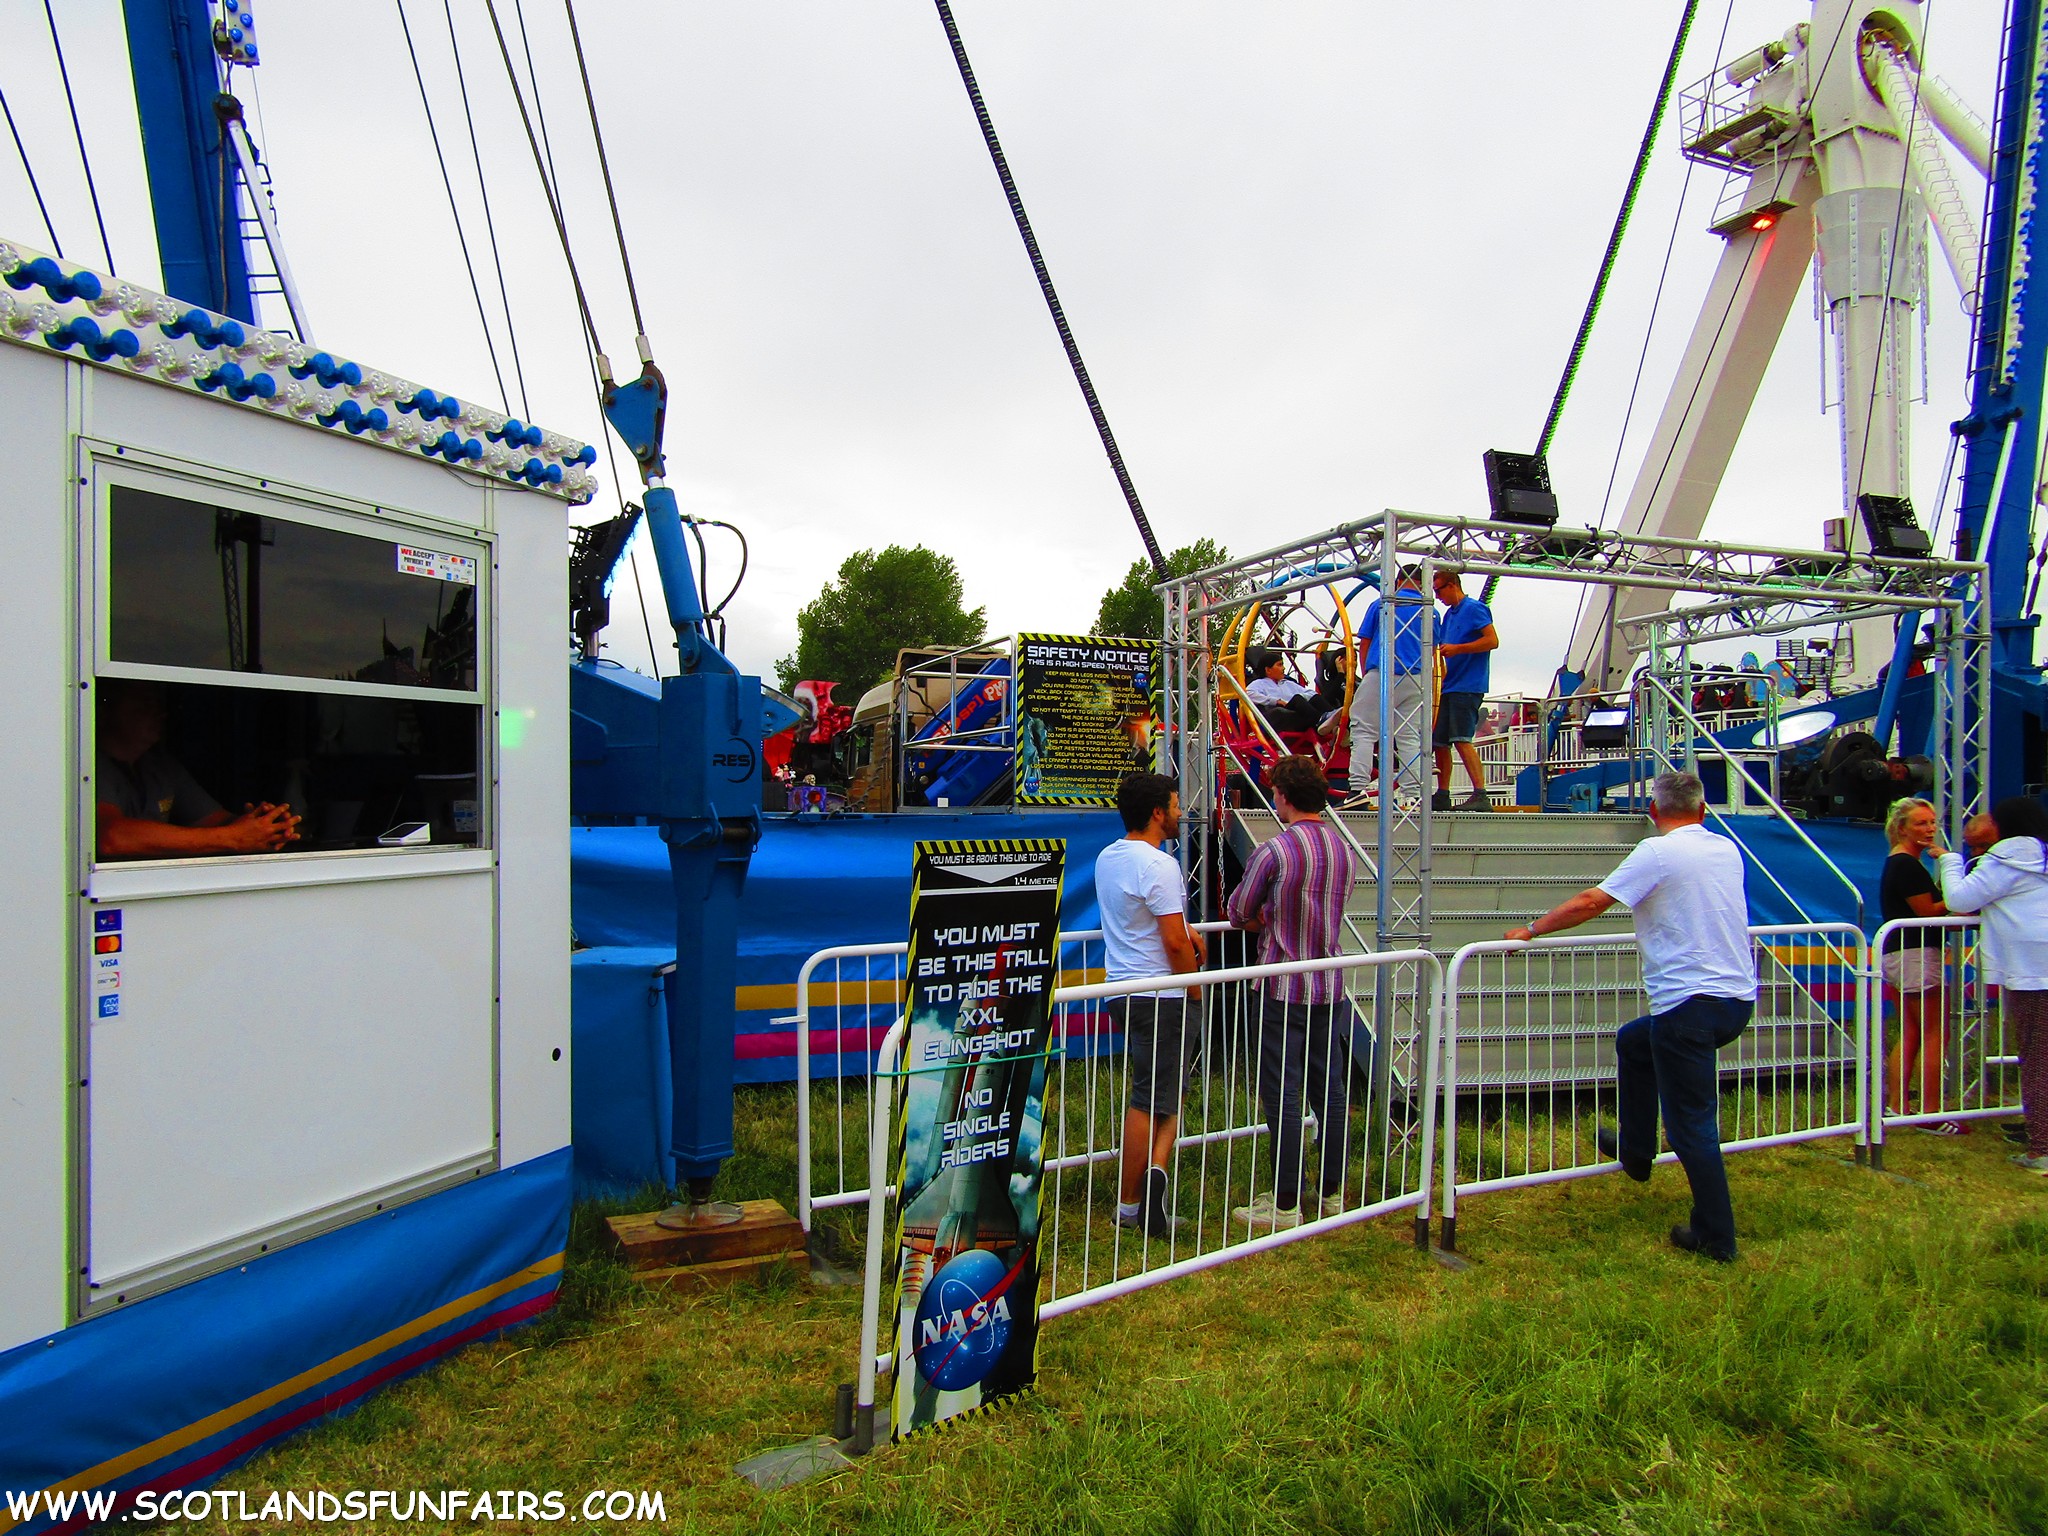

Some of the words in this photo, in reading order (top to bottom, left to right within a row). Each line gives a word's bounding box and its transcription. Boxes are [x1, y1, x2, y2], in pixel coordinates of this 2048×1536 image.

[400, 547, 413, 555] WE
[413, 549, 435, 560] ACCEPT
[403, 556, 424, 566] PAYMENT
[1027, 645, 1090, 660] SAFETY
[1094, 649, 1148, 664] NOTICE
[1027, 658, 1045, 666] THIS
[1062, 660, 1080, 668] HIGH
[1081, 661, 1106, 669] SPEED
[1106, 663, 1132, 671] THRILL
[1133, 664, 1150, 672] RIDE
[712, 753, 751, 767] RES
[929, 855, 945, 865] YOU
[945, 855, 965, 864] MUST
[966, 854, 975, 864] BE
[976, 854, 998, 863] ABOVE
[999, 853, 1014, 862] THIS
[1014, 853, 1028, 862] LINE
[1028, 853, 1038, 861] TO
[1038, 852, 1052, 861] RIDE
[1014, 877, 1027, 886] 1.4
[1028, 877, 1058, 885] METRE
[933, 925, 977, 947] YOU
[982, 922, 1040, 943] MUST
[100, 958, 119, 968] VISA
[918, 956, 946, 976] BE
[952, 952, 997, 973] THIS
[1002, 948, 1049, 969] TALL
[924, 984, 953, 1004] TO
[958, 979, 1000, 1001] RIDE
[1005, 975, 1043, 995] THE
[962, 1006, 1004, 1028] XXL
[924, 1028, 1036, 1061] SLINGSHOT
[964, 1088, 993, 1110] NO
[943, 1111, 1011, 1141] SINGLE
[941, 1138, 1010, 1169] RIDERS
[920, 1295, 1012, 1347] NASA
